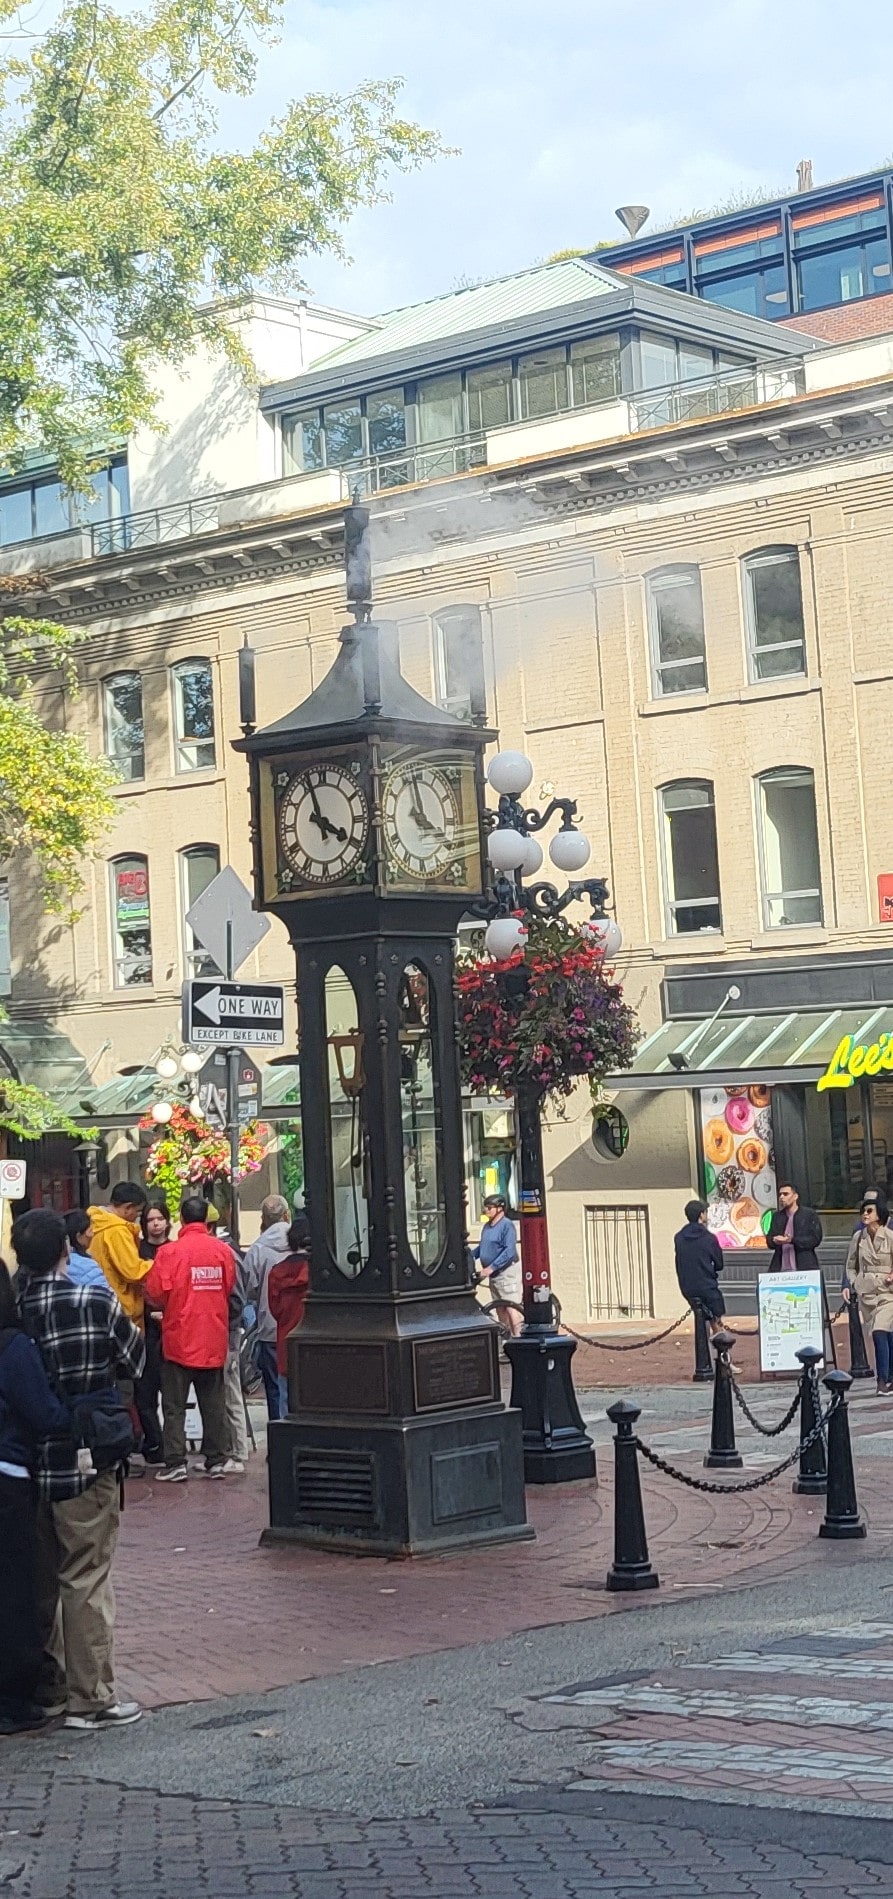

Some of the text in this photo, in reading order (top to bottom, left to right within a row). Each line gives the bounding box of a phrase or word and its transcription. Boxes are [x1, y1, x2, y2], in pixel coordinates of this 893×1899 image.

[218, 998, 278, 1015] ONE WAY
[197, 1030, 277, 1041] EXCEPT BIKE LANE
